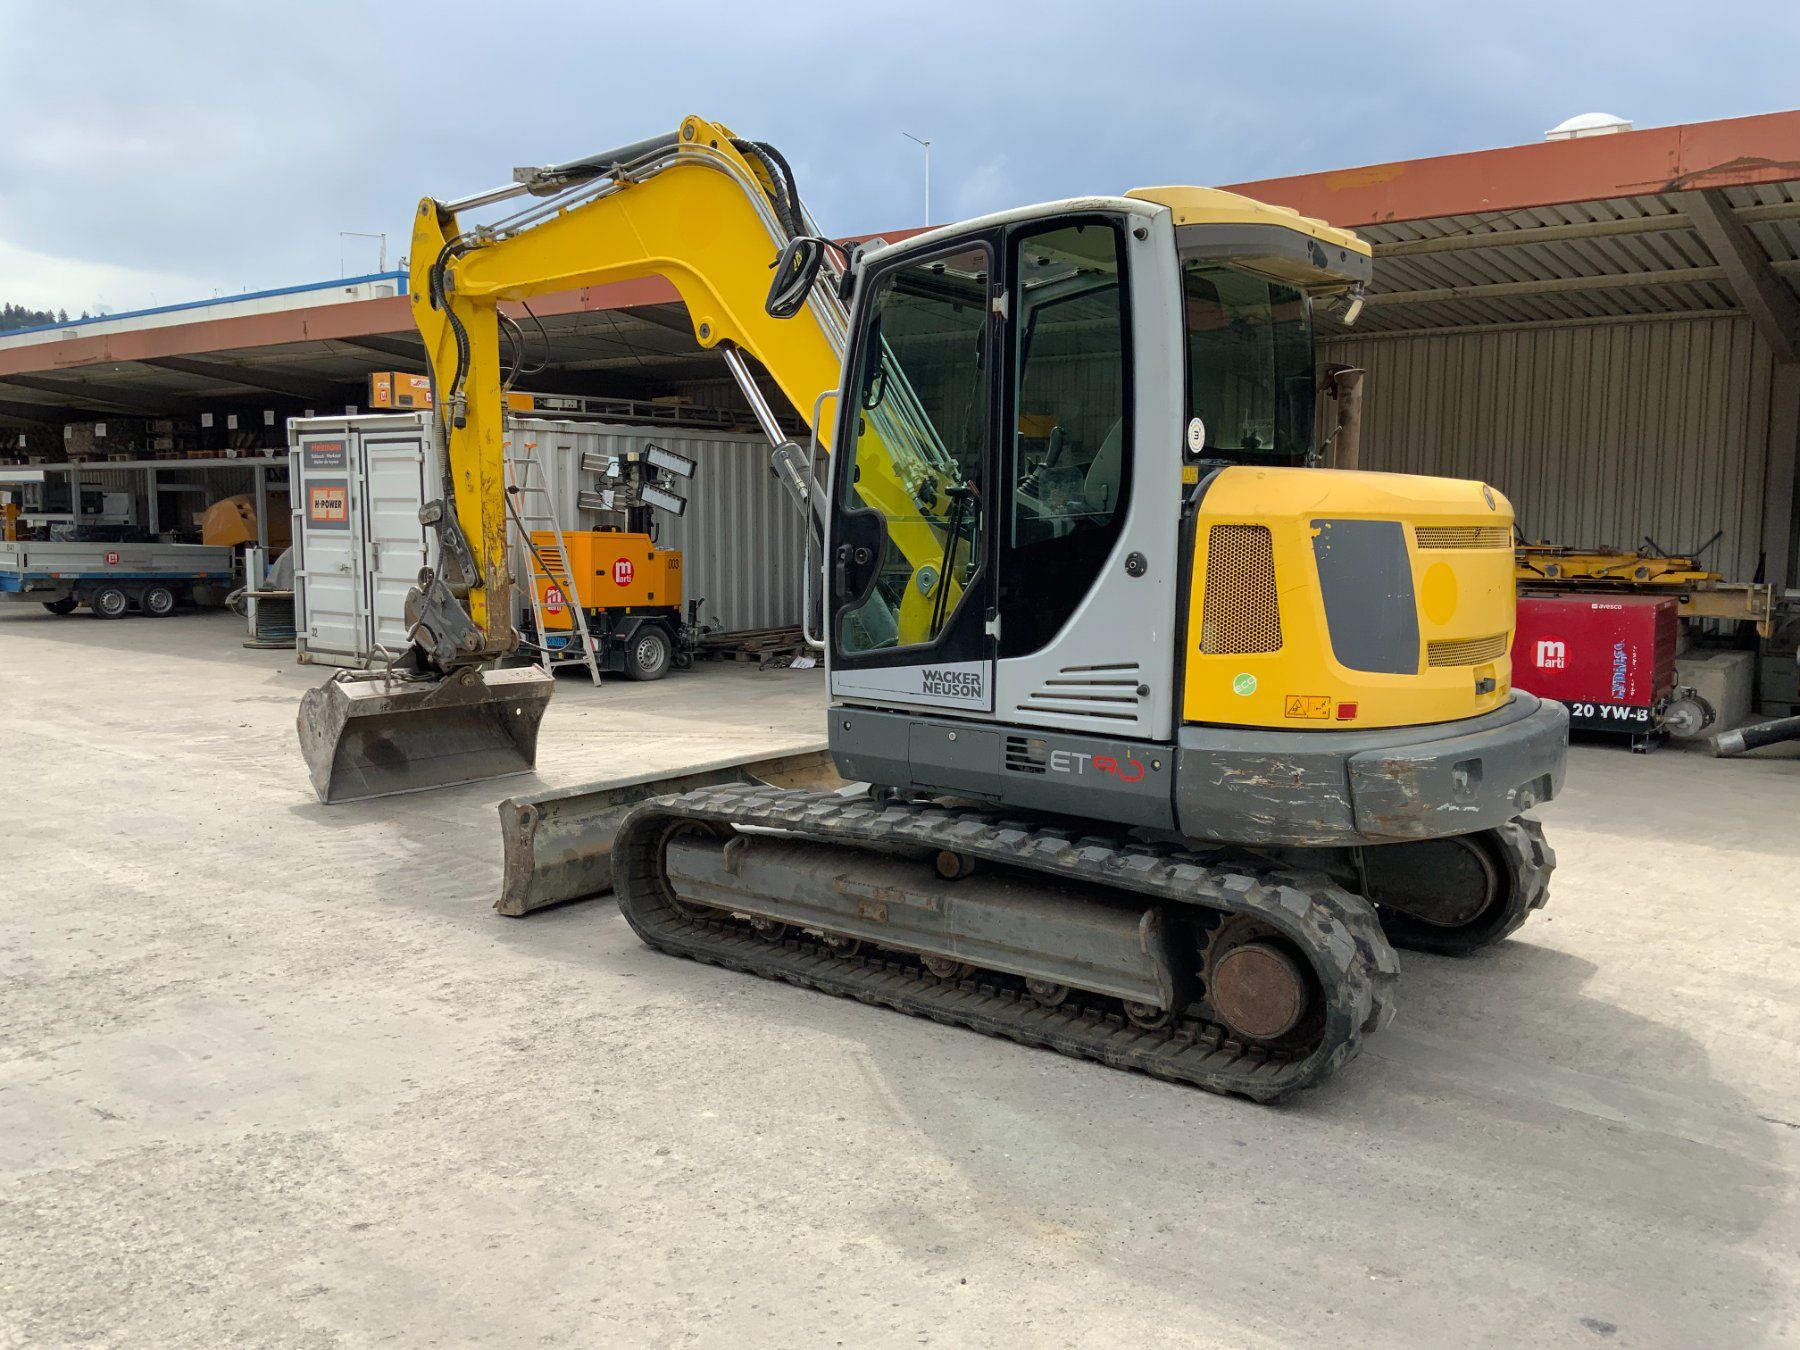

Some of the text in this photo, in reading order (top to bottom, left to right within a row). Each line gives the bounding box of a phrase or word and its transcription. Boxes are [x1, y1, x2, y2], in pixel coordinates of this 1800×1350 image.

[314, 499, 342, 509] H-POWER
[922, 669, 981, 686] WACKER
[922, 681, 982, 698] NEUSON
[1572, 703, 1595, 718] 20
